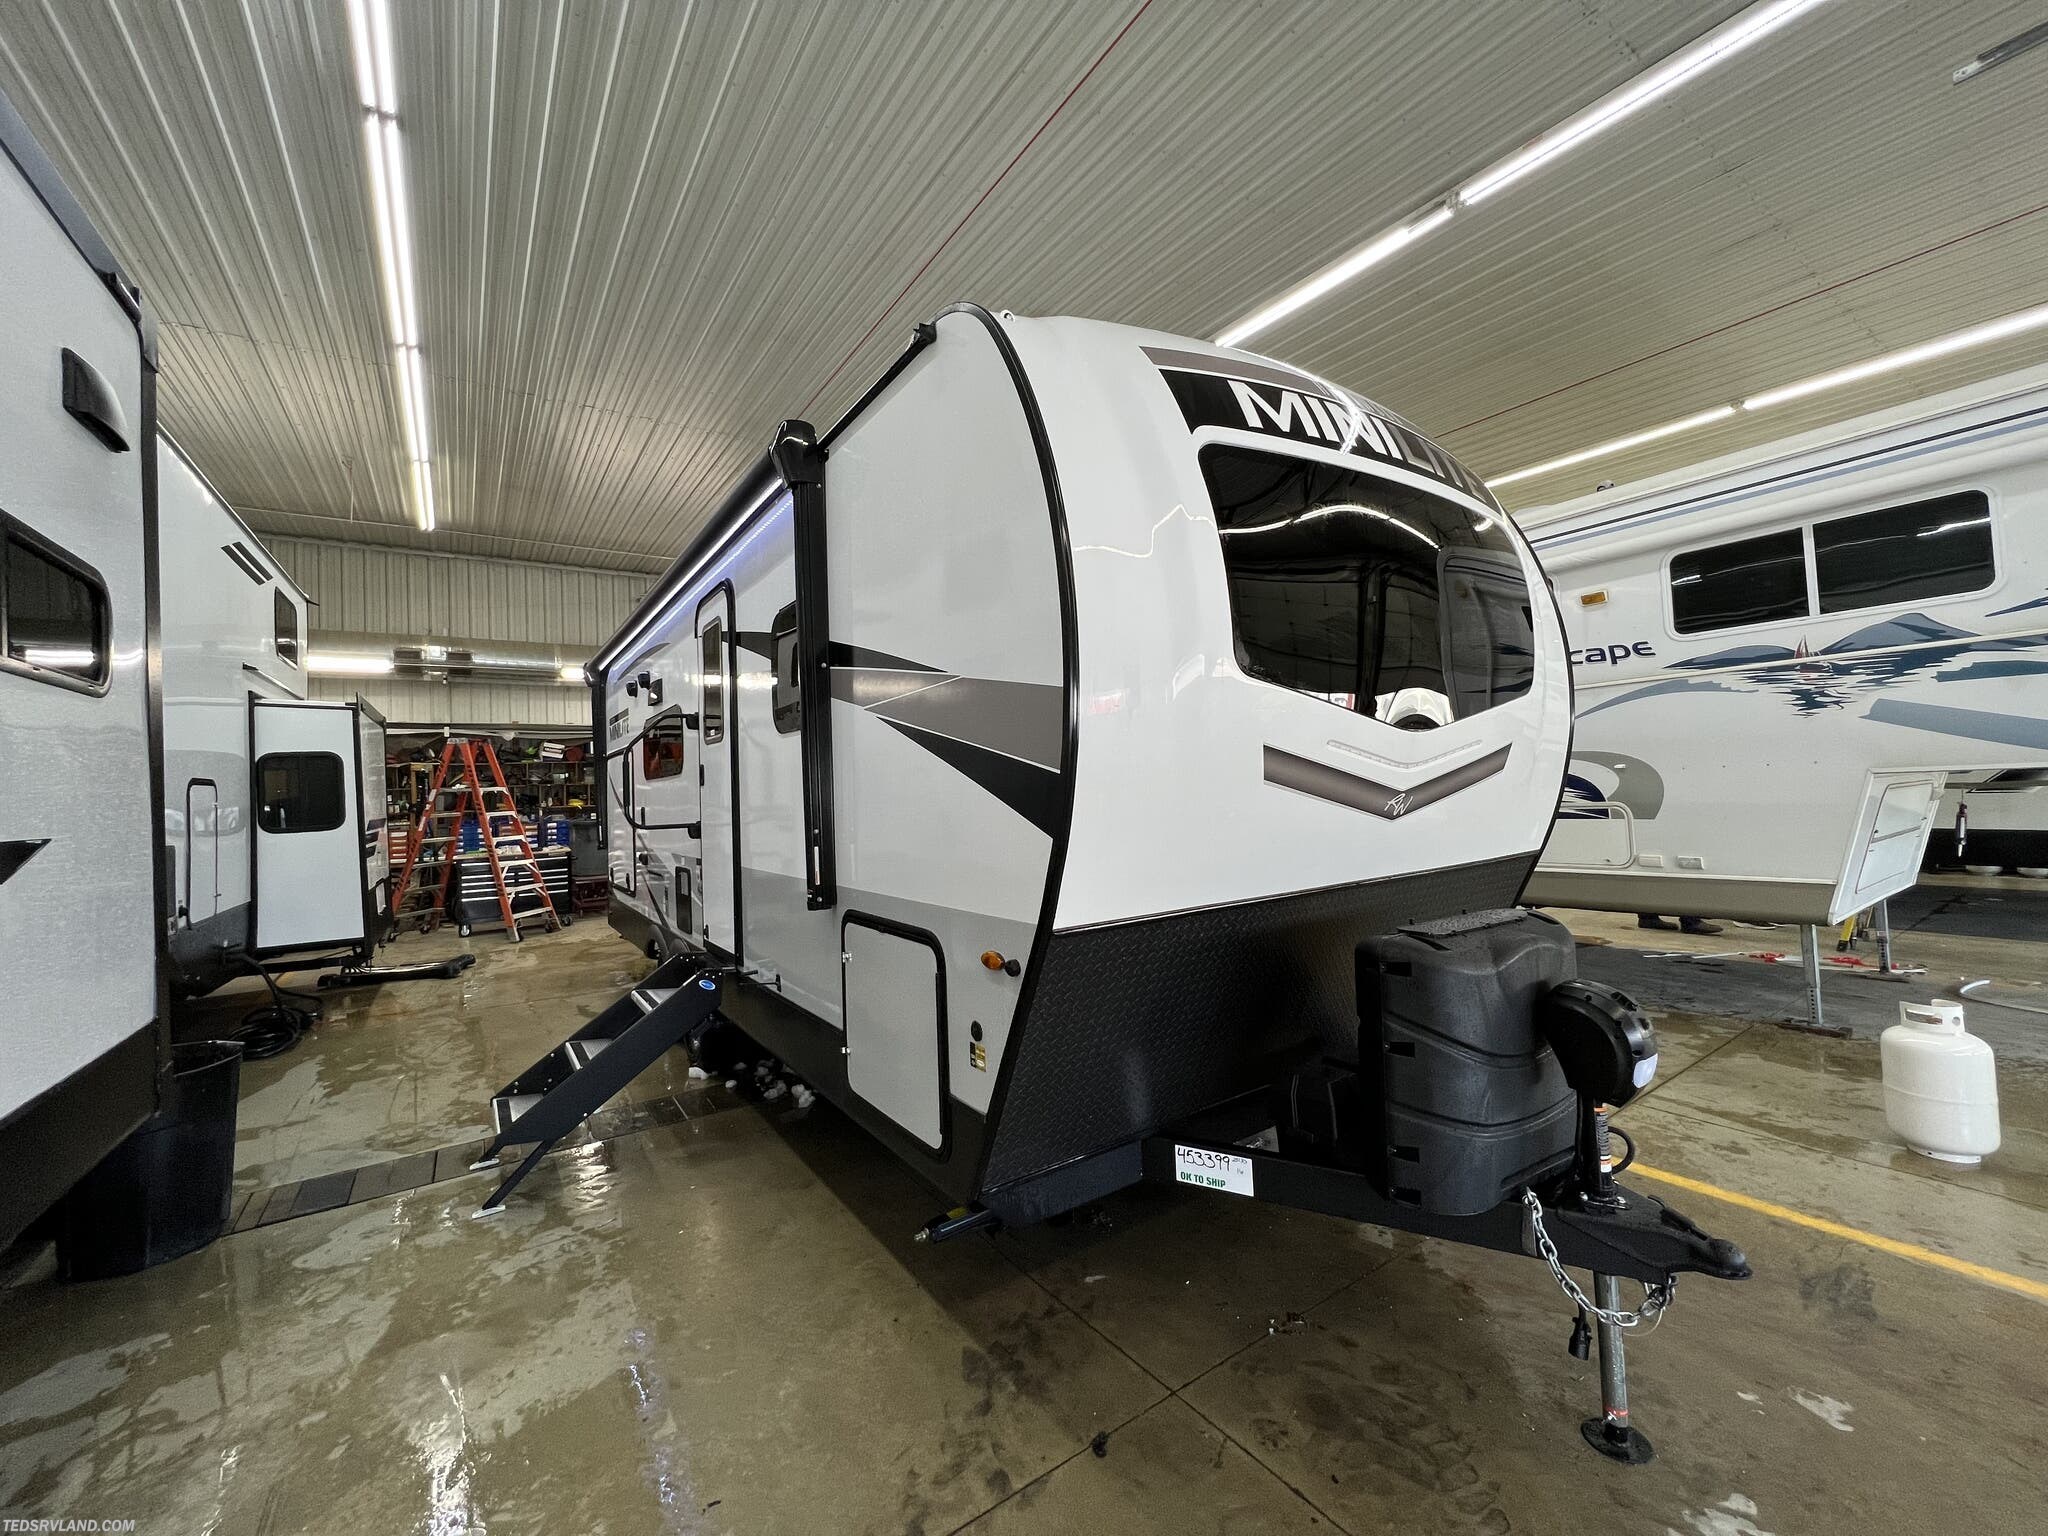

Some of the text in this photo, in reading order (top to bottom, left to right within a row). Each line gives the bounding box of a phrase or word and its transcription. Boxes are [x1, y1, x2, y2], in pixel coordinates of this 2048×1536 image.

[1177, 1147, 1230, 1172] 453399
[1180, 1171, 1226, 1188] OK TO SHIP
